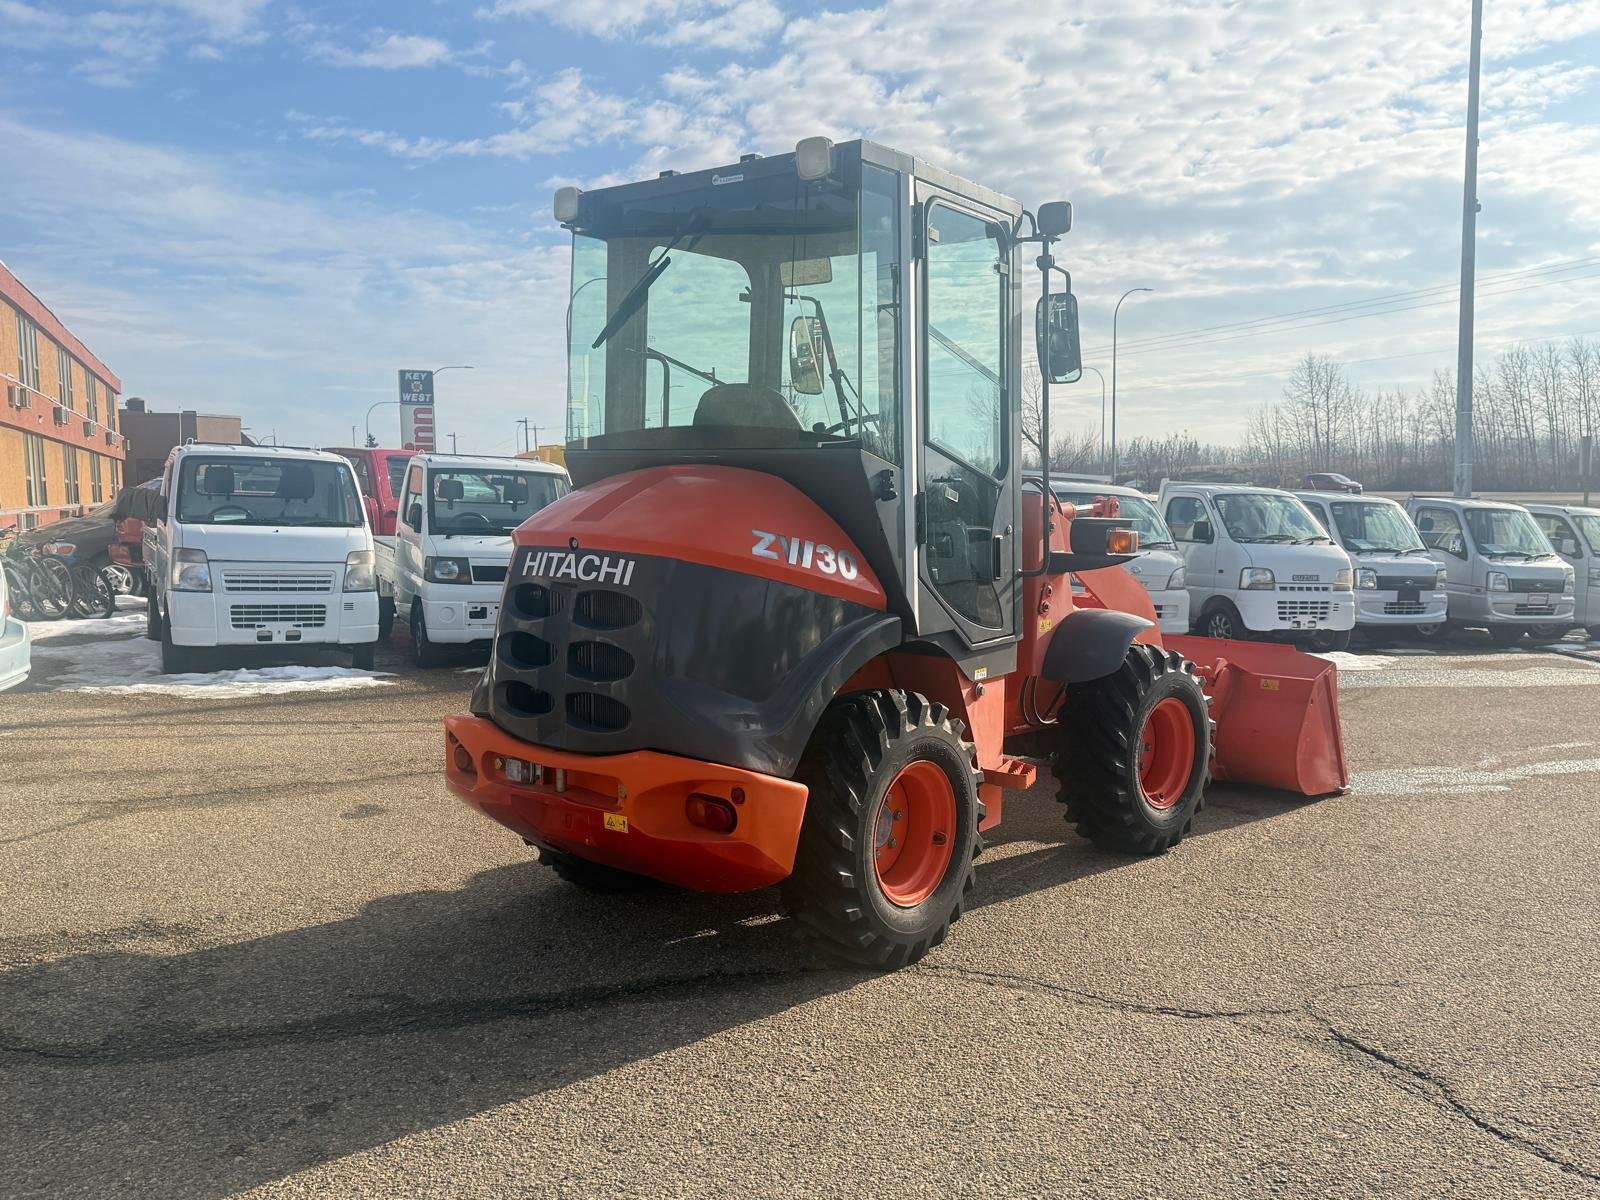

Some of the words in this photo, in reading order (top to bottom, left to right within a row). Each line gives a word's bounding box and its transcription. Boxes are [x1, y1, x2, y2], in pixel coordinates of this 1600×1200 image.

[405, 372, 427, 380] KEY
[402, 393, 432, 402] WEST
[752, 530, 857, 581] ZW30
[522, 552, 635, 586] HITACHI
